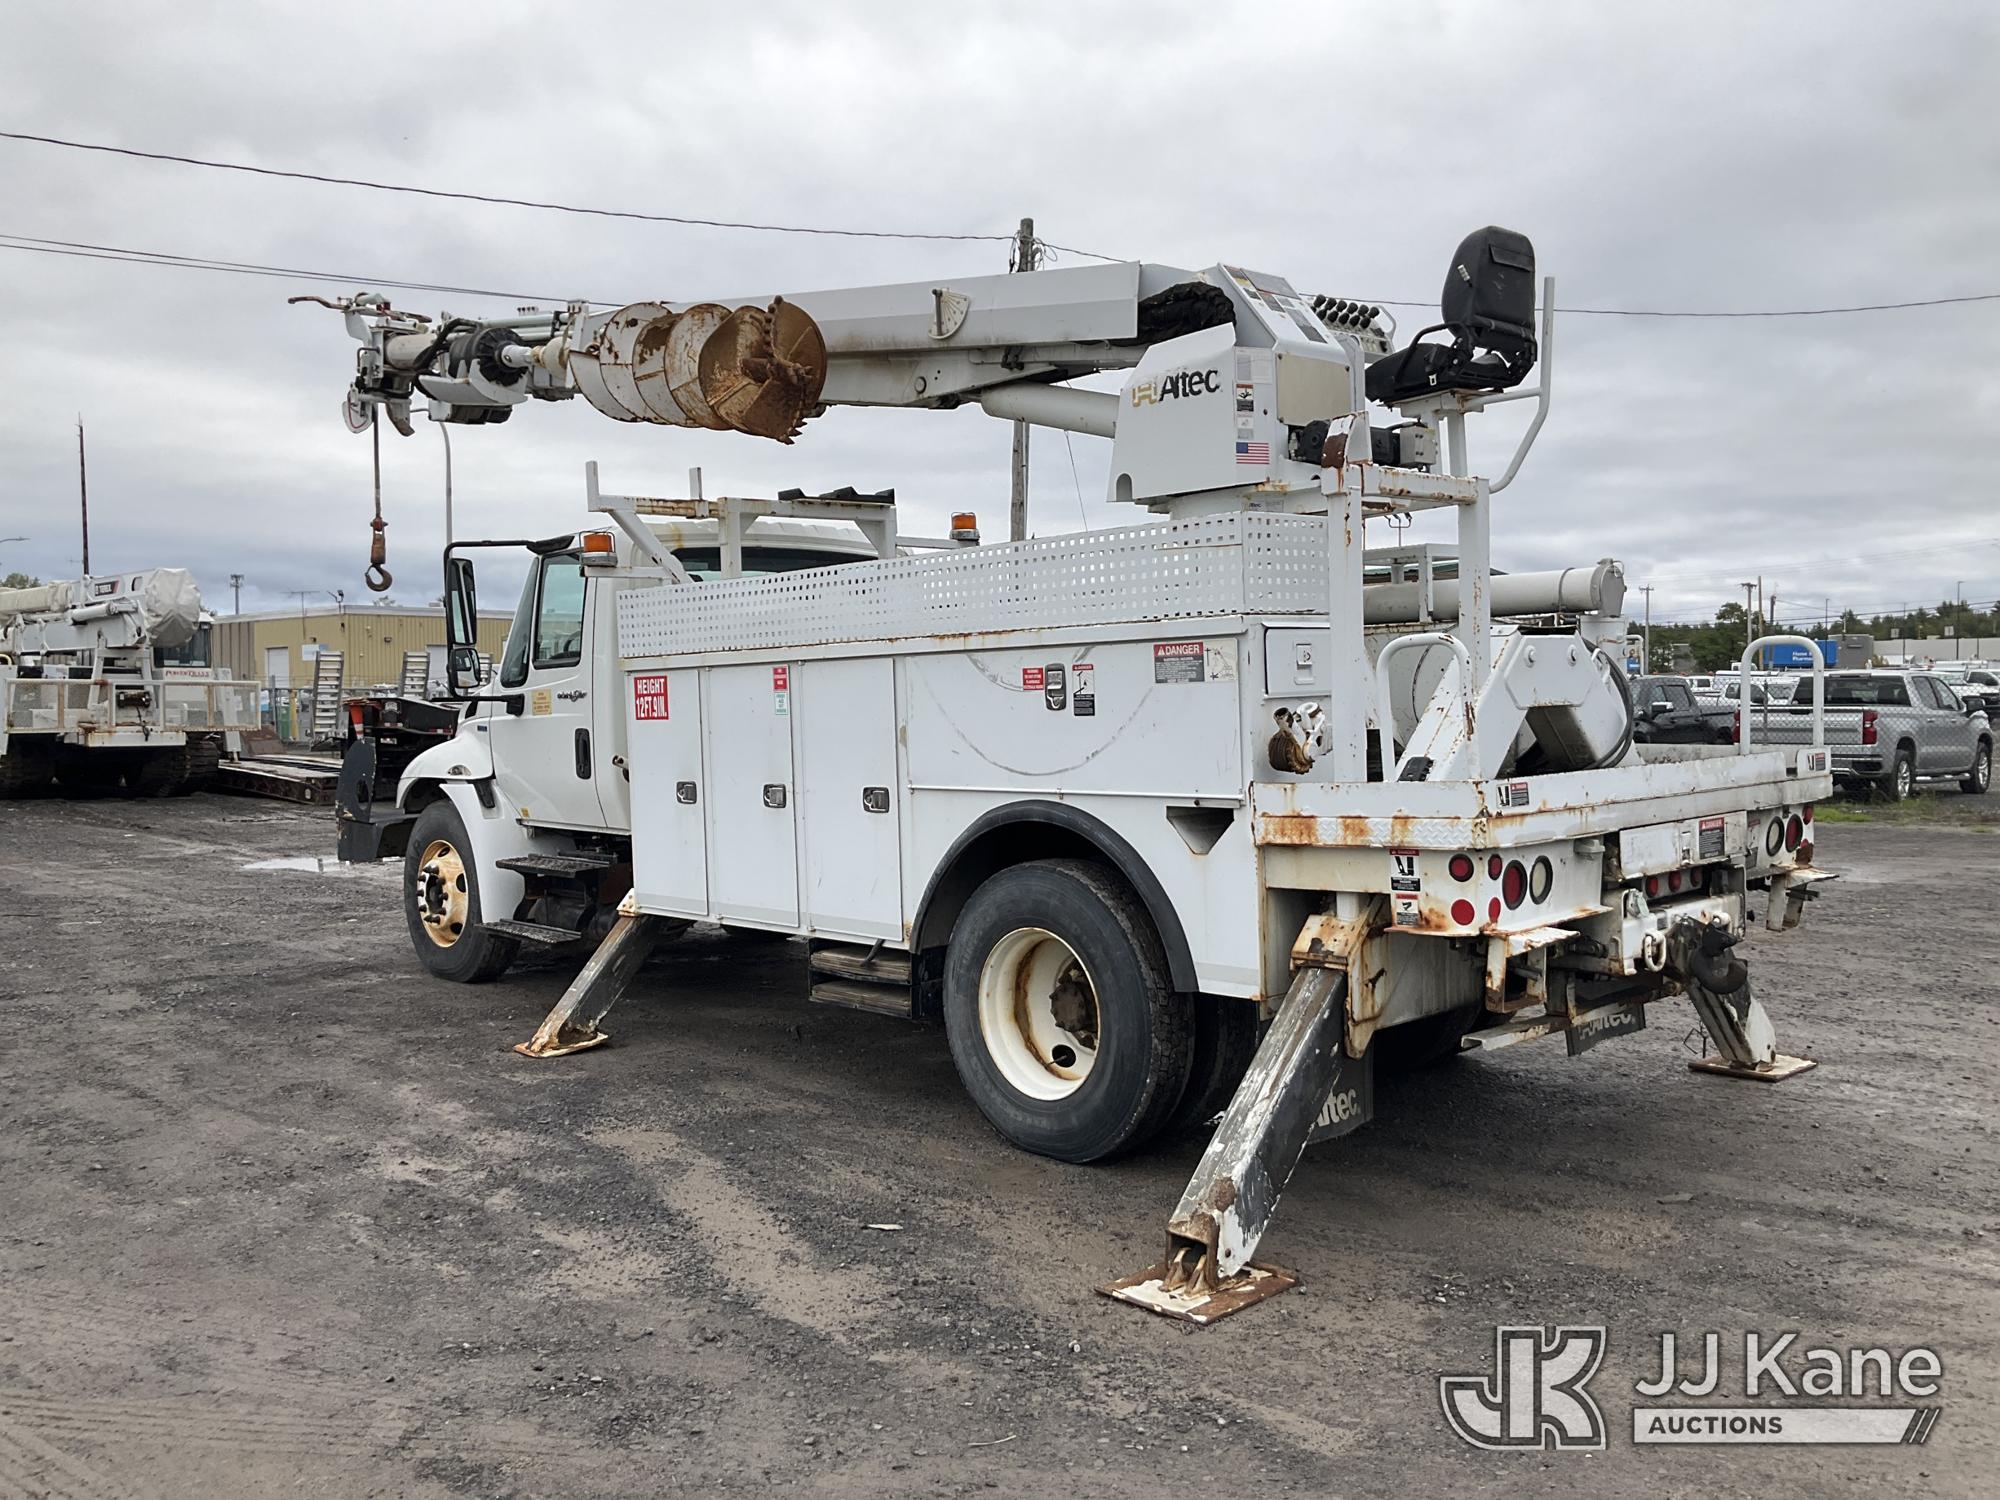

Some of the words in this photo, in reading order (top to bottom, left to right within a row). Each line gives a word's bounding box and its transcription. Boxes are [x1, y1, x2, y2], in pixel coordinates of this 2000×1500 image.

[1158, 369, 1221, 402] Altec
[1165, 644, 1200, 655] DANGER
[637, 678, 664, 694] HEIGHT
